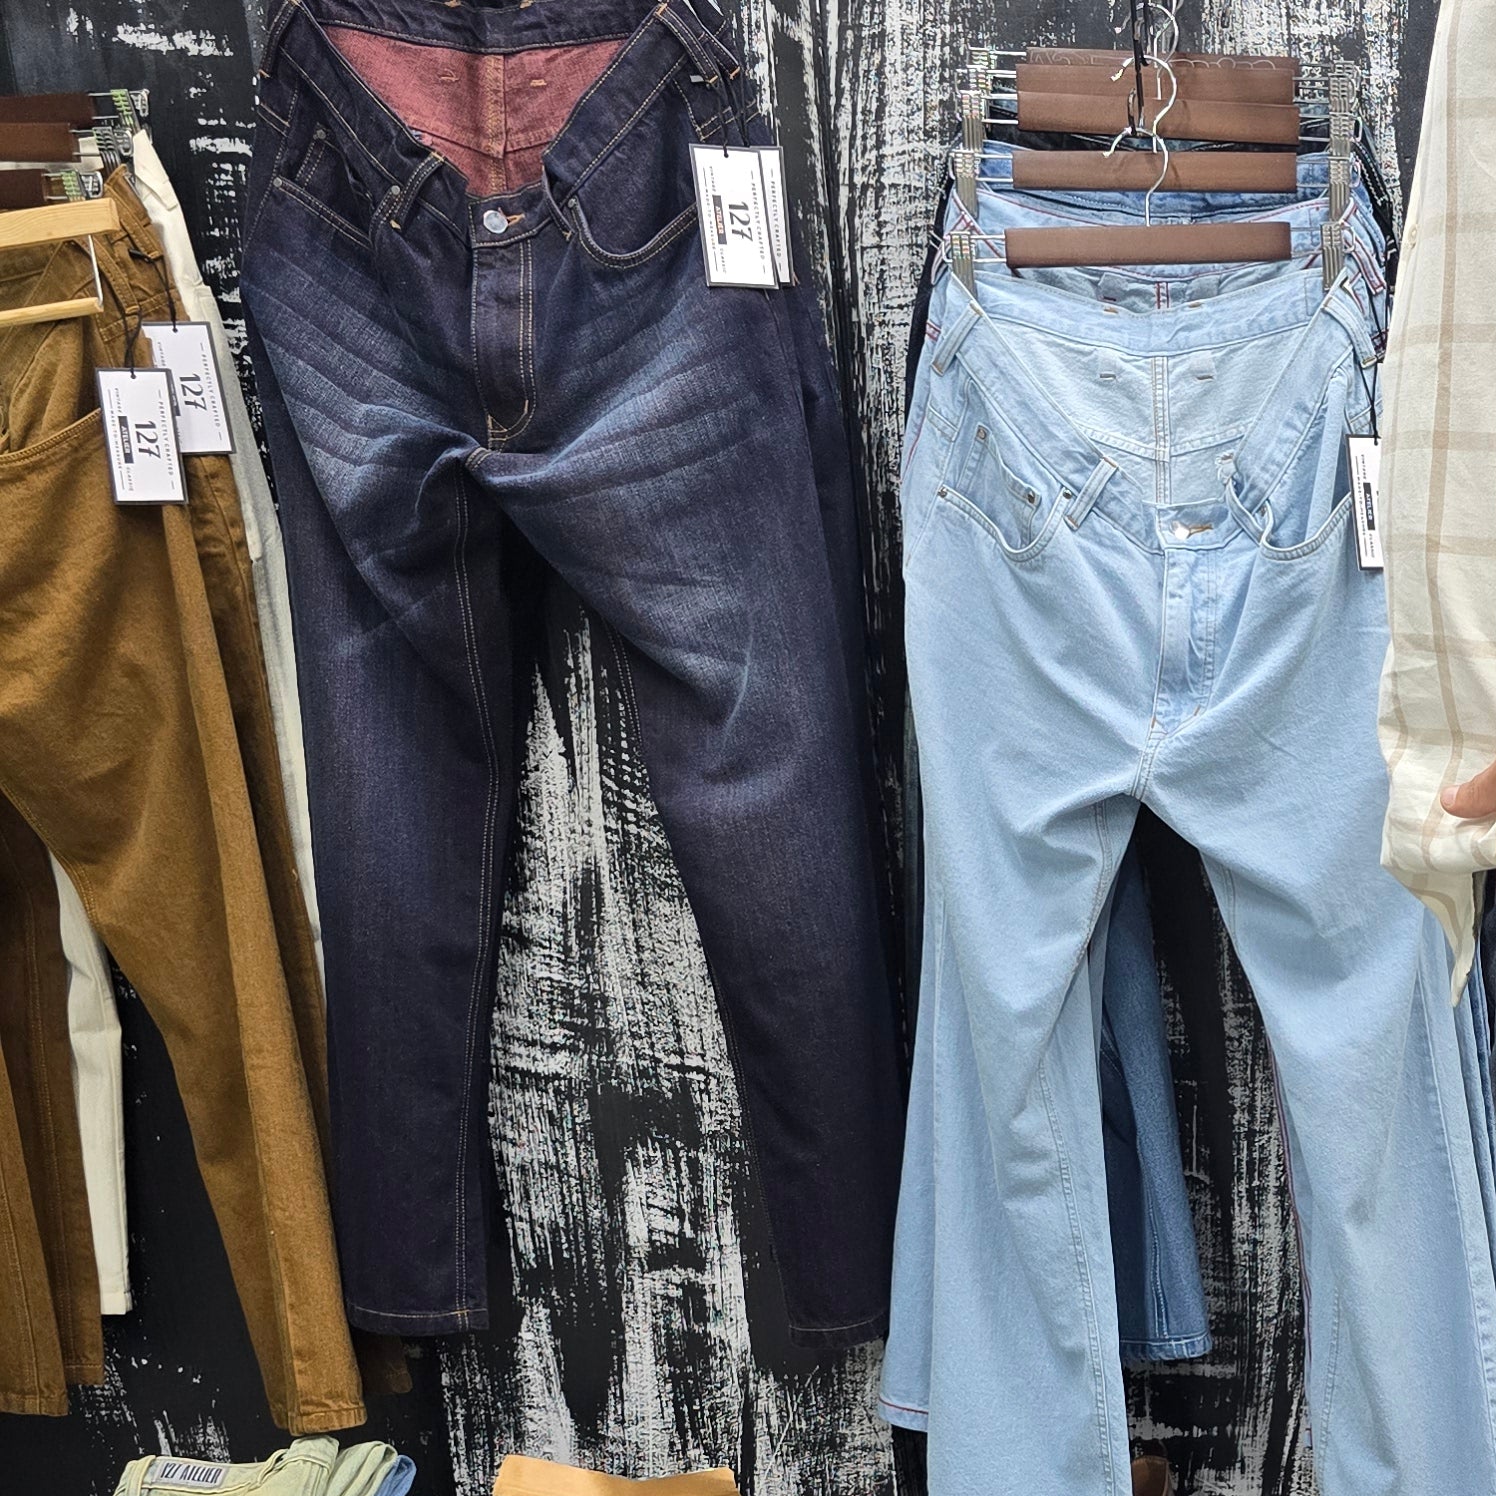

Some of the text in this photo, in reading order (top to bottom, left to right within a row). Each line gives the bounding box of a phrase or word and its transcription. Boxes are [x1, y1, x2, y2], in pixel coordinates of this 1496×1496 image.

[728, 201, 754, 242] 127
[179, 373, 207, 411] 127
[134, 420, 161, 459] 127
